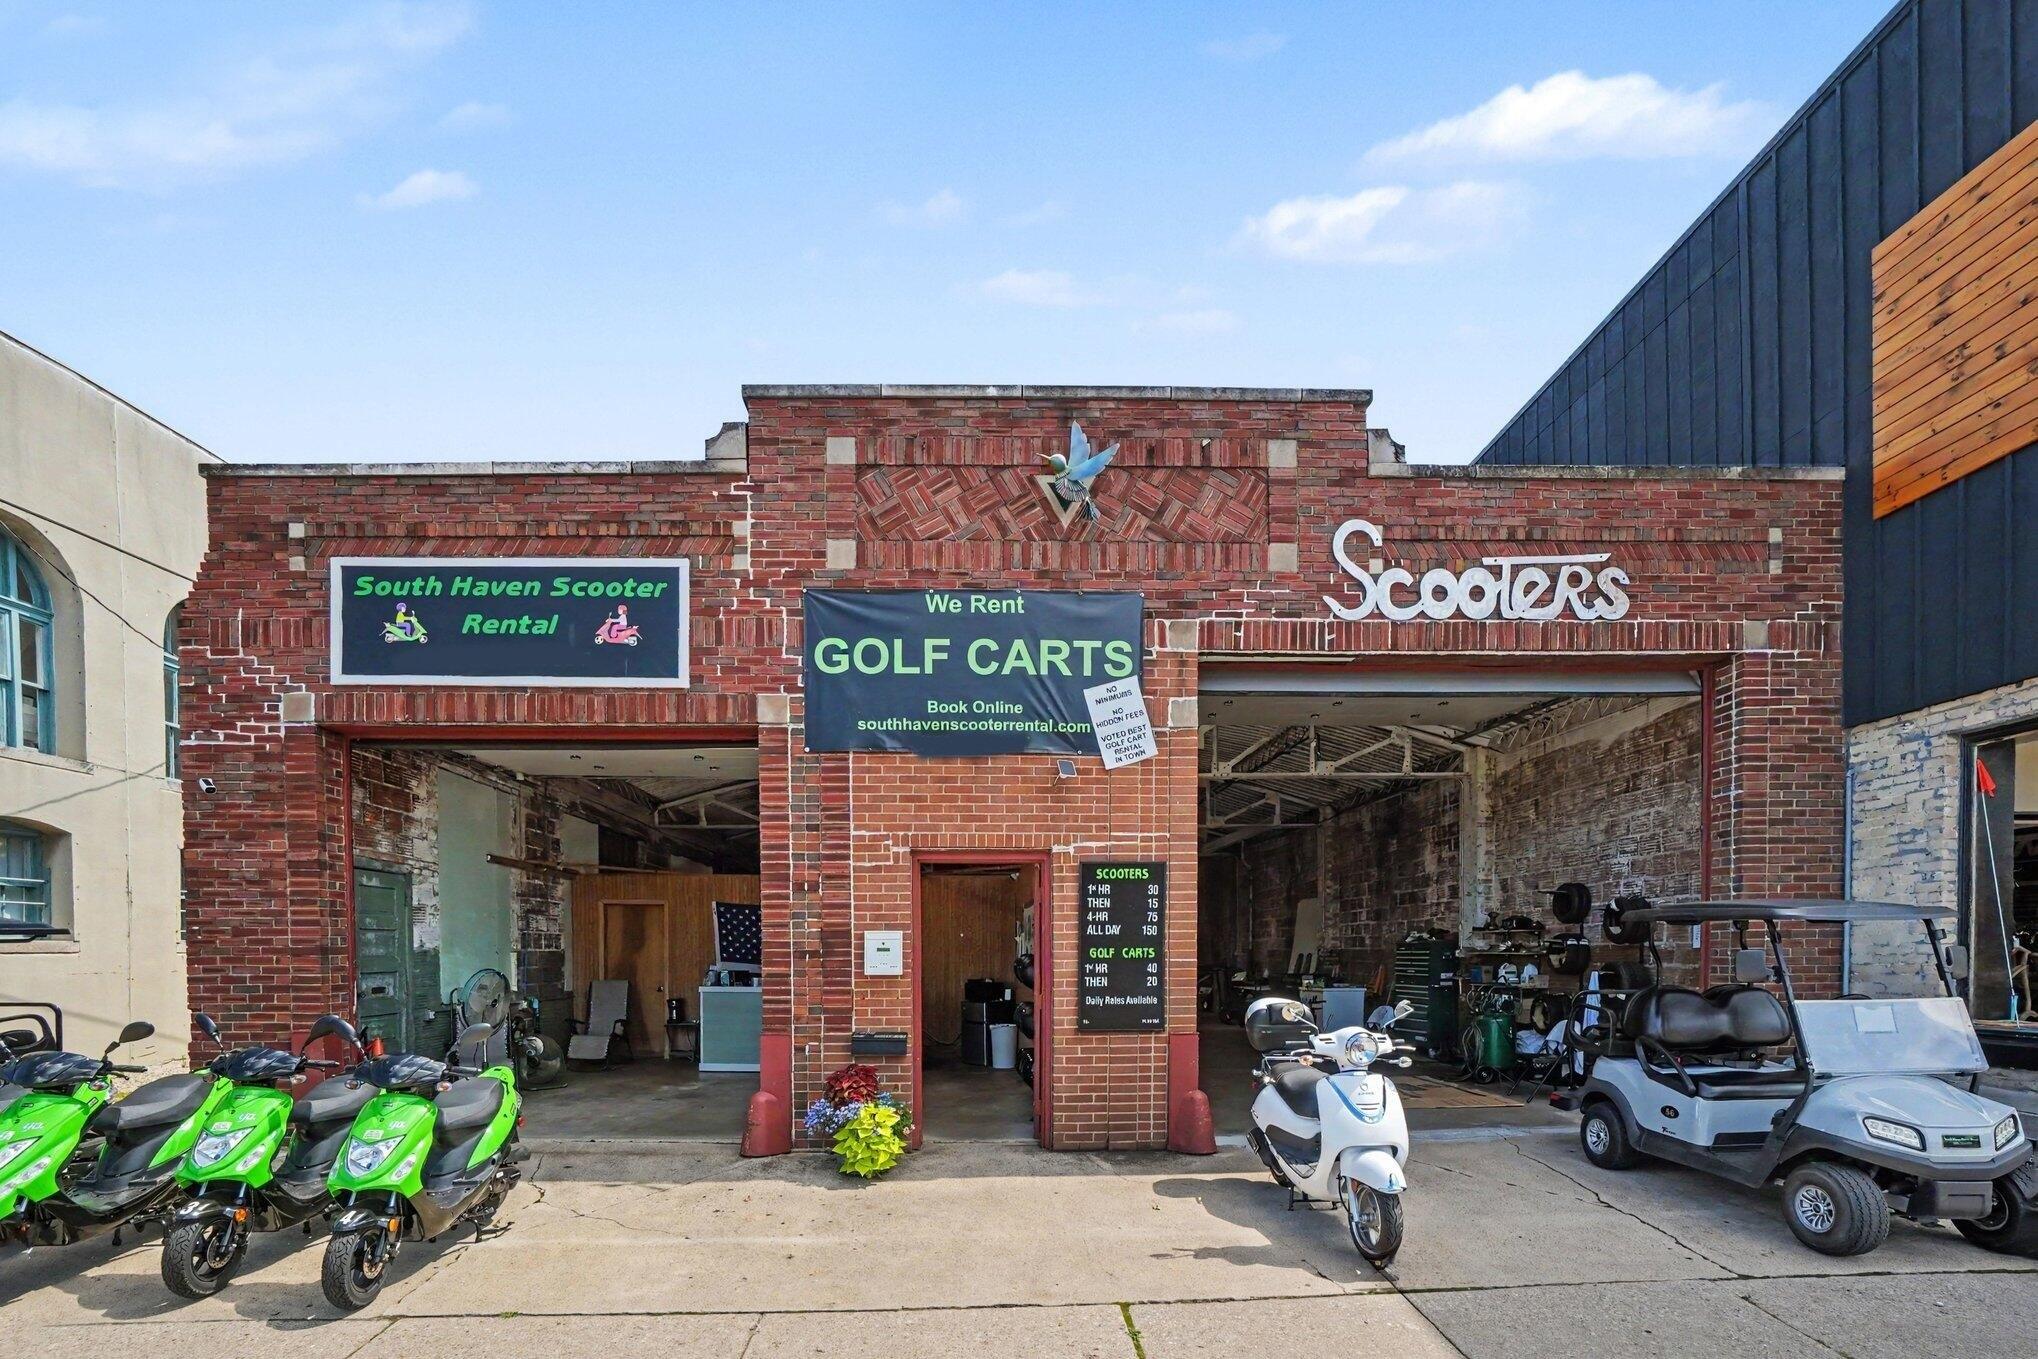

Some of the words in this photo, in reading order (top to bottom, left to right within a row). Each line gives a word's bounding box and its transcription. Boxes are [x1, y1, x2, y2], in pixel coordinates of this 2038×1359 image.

[353, 575, 442, 597] South
[450, 576, 541, 597] Haven
[549, 576, 668, 598] Scooter
[925, 594, 962, 614] We
[970, 594, 1025, 614] Rent
[461, 613, 560, 636] Rental
[813, 637, 951, 675] GOLF
[966, 638, 1134, 677] CARTS
[1106, 685, 1118, 694] NO
[927, 700, 968, 714] Book
[973, 700, 1023, 715] Online
[1112, 707, 1124, 716] NO
[857, 716, 1091, 734] southhavenscooterrental.com
[1100, 730, 1126, 743] VOTED
[1127, 723, 1147, 736] BEST
[1105, 739, 1125, 750] GOLF
[1126, 732, 1147, 744] CART
[1114, 743, 1143, 755] RENTAL
[1115, 756, 1123, 764] IN
[1124, 749, 1146, 761] TOWN
[1096, 869, 1150, 880] SCOOTERS
[1098, 884, 1111, 895] HR
[1147, 884, 1159, 895] 30
[1087, 898, 1111, 908] THEN
[1147, 898, 1159, 909] 15
[1086, 924, 1104, 935] ALL
[1105, 924, 1121, 935] DAY
[1142, 925, 1158, 936] 150
[1089, 947, 1115, 959] GOLF
[1122, 947, 1156, 959] CARTS
[1095, 963, 1108, 974] HR
[1146, 962, 1158, 973] 40
[1084, 976, 1108, 987] THEN
[1146, 976, 1158, 987] 20
[1085, 996, 1104, 1007] Daily
